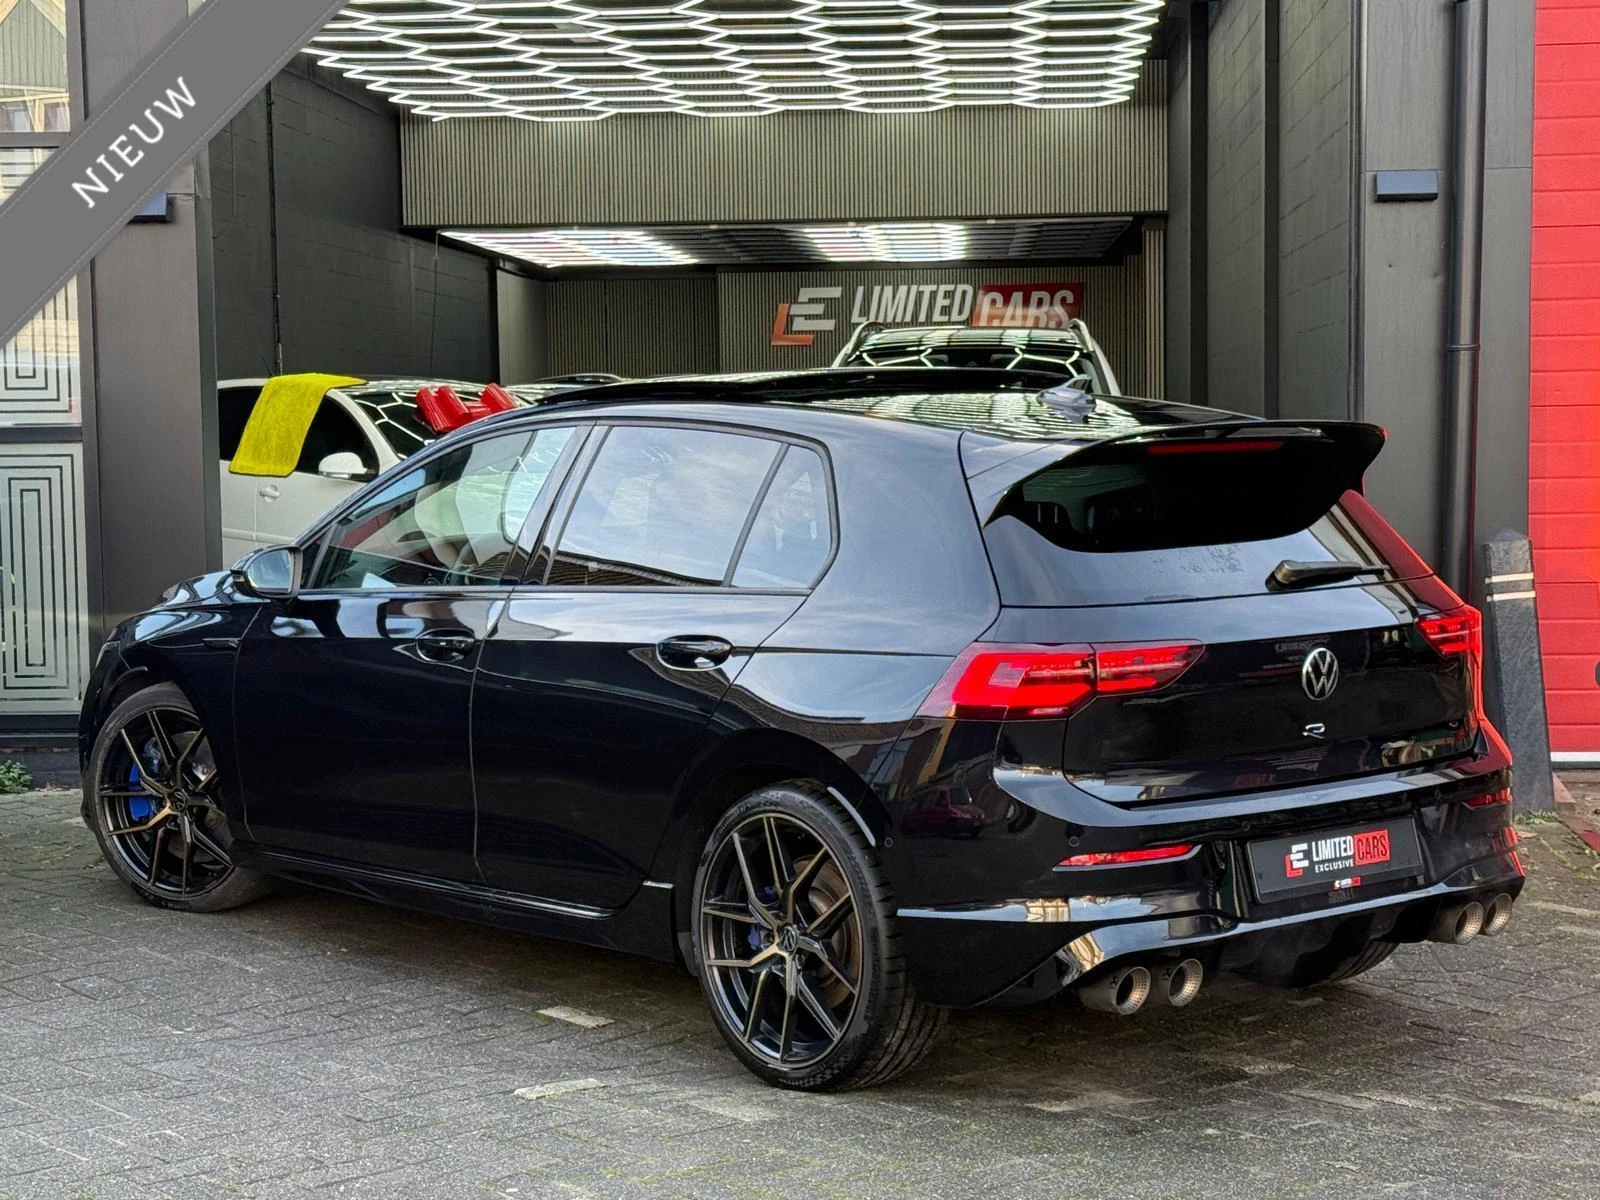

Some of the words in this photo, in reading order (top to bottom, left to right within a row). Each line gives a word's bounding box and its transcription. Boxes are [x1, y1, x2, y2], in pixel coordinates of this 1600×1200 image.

[851, 284, 973, 324] LIMITED
[979, 290, 1074, 328] CARS
[1311, 835, 1354, 862] LIMITED
[1357, 834, 1388, 861] CARS
[1315, 859, 1354, 873] EXCLUSIVE
